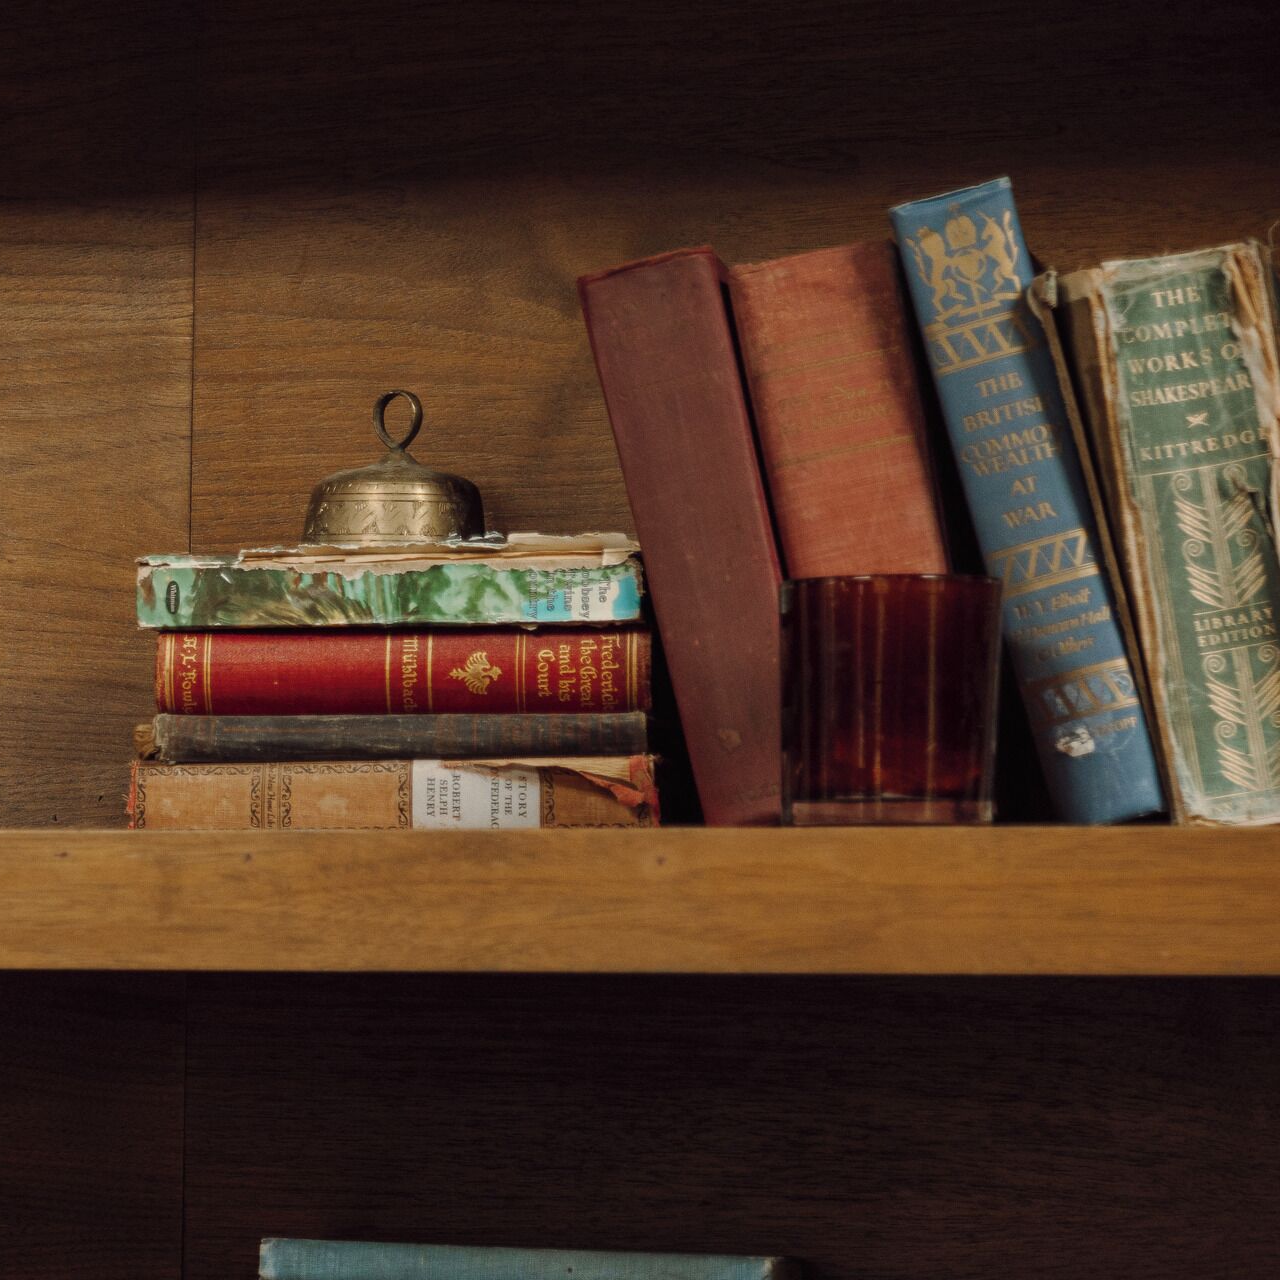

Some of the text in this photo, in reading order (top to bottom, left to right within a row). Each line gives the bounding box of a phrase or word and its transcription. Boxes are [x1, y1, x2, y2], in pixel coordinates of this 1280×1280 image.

[1151, 286, 1202, 309] THE
[1128, 348, 1213, 376] WORKS
[975, 371, 1025, 398] THE
[1010, 476, 1038, 497] AT
[1001, 502, 1058, 529] WAR
[546, 589, 556, 612] the
[599, 578, 611, 604] The
[1193, 607, 1274, 632] LIBRARY
[1197, 623, 1278, 648] EDITION
[580, 638, 598, 668] the
[537, 650, 556, 698] Court
[558, 644, 571, 703] and his
[426, 777, 436, 818] HENRY
[439, 779, 449, 817] SELPH
[451, 774, 462, 822] ROBERT
[504, 794, 513, 817] THE
[517, 775, 528, 819] STORY
